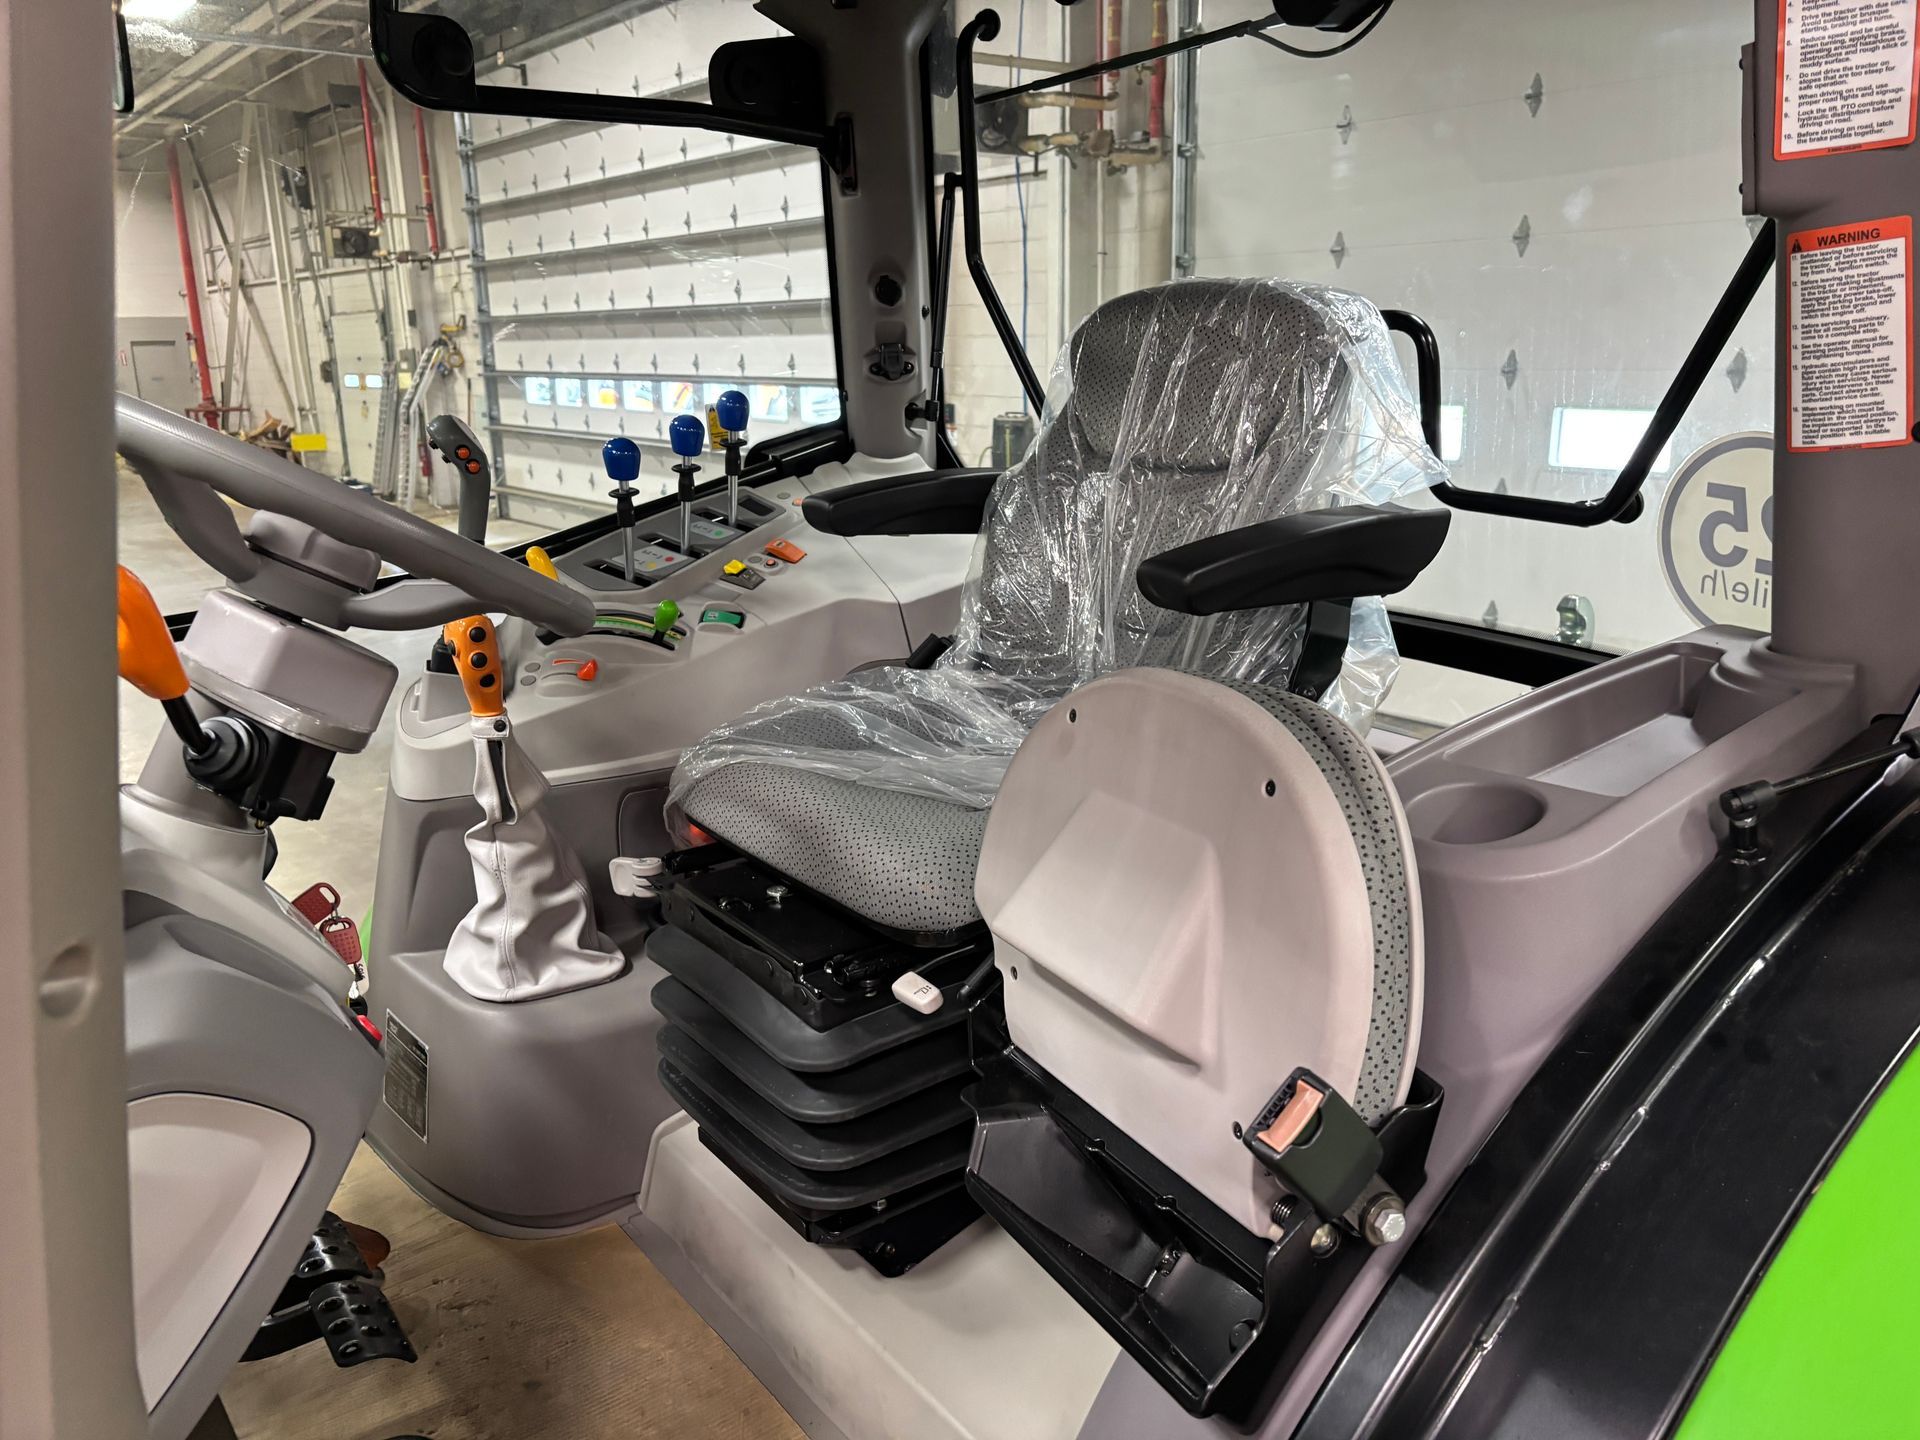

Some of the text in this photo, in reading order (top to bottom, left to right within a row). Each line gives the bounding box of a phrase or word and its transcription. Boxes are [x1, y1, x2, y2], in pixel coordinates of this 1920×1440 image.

[1834, 7, 1857, 16] tractor
[1859, 3, 1873, 11] with
[1802, 19, 1821, 27] Avoid
[1823, 16, 1848, 24] sudden
[1860, 9, 1889, 18] brusque
[1831, 20, 1857, 29] braking
[1801, 36, 1826, 44] Reduce
[1828, 31, 1848, 40] speed
[1850, 28, 1862, 36] and
[1875, 22, 1899, 32] careful
[1849, 33, 1878, 43] applying
[1800, 47, 1832, 57] operating
[1834, 42, 1857, 51] around
[1860, 37, 1895, 47] hazardous
[1800, 52, 1842, 62] obstructions
[1859, 45, 1880, 53] rough
[1800, 61, 1822, 69] muddy
[1856, 62, 1877, 70] tractor
[1799, 77, 1821, 85] slopes
[1815, 80, 1848, 89] operation.
[1820, 89, 1843, 97] driving
[1798, 99, 1820, 108] proper
[1822, 95, 1838, 103] road
[1840, 93, 1858, 101] lights
[1858, 99, 1886, 108] controls
[1888, 96, 1901, 104] and
[1798, 114, 1829, 123] hydraulic
[1831, 109, 1870, 118] distributors
[1800, 121, 1822, 129] driving
[1821, 127, 1844, 135] driving
[1809, 135, 1828, 143] brake
[1830, 132, 1852, 141] pedals
[1817, 228, 1880, 247] WARNING
[1820, 249, 1842, 257] leaving
[1866, 247, 1897, 256] servicing
[1860, 255, 1884, 263] remove
[1838, 264, 1863, 273] ignition
[1801, 283, 1826, 291] servicing
[1837, 279, 1860, 287] making
[1863, 273, 1904, 283] adjustments
[1820, 275, 1842, 283] leaving
[1844, 291, 1864, 299] power
[1828, 298, 1852, 307] parking
[1853, 300, 1877, 309] ground
[1832, 309, 1853, 317] engine
[1821, 319, 1850, 327] servicing
[1859, 322, 1875, 330] parts
[1831, 329, 1860, 337] complete
[1823, 339, 1851, 348] operator
[1853, 335, 1877, 344] manual
[1872, 340, 1893, 348] points
[1830, 358, 1874, 367] accumulators
[1818, 362, 1889, 374] contain high pressure
[1819, 389, 1843, 397] Contact
[1856, 399, 1884, 407] mounted
[1812, 420, 1843, 429] implement
[1830, 424, 1862, 433] supported
[1821, 431, 1845, 440] position
[1865, 427, 1890, 435] suitable
